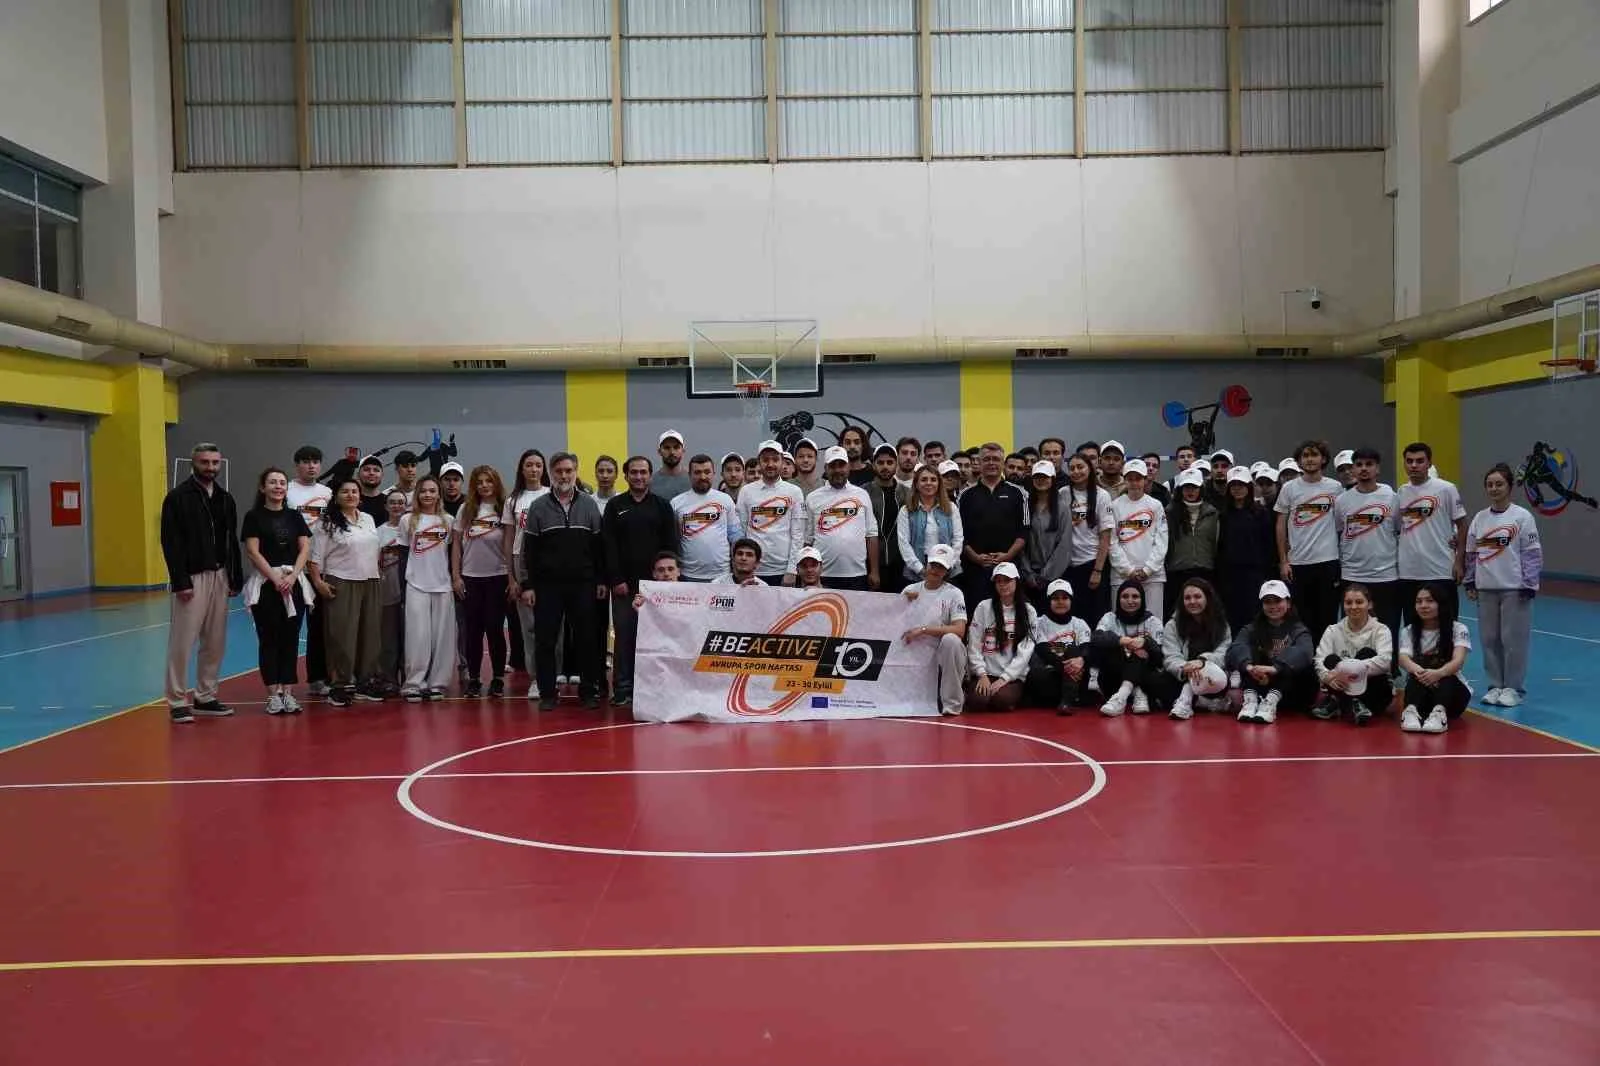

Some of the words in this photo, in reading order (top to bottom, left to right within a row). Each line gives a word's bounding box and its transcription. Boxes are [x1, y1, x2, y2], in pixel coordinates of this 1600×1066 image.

[708, 634, 822, 658] #BEACTIVE
[709, 660, 742, 670] AVRUPA
[744, 661, 767, 671] SPOR
[768, 662, 803, 672] HAFTASI
